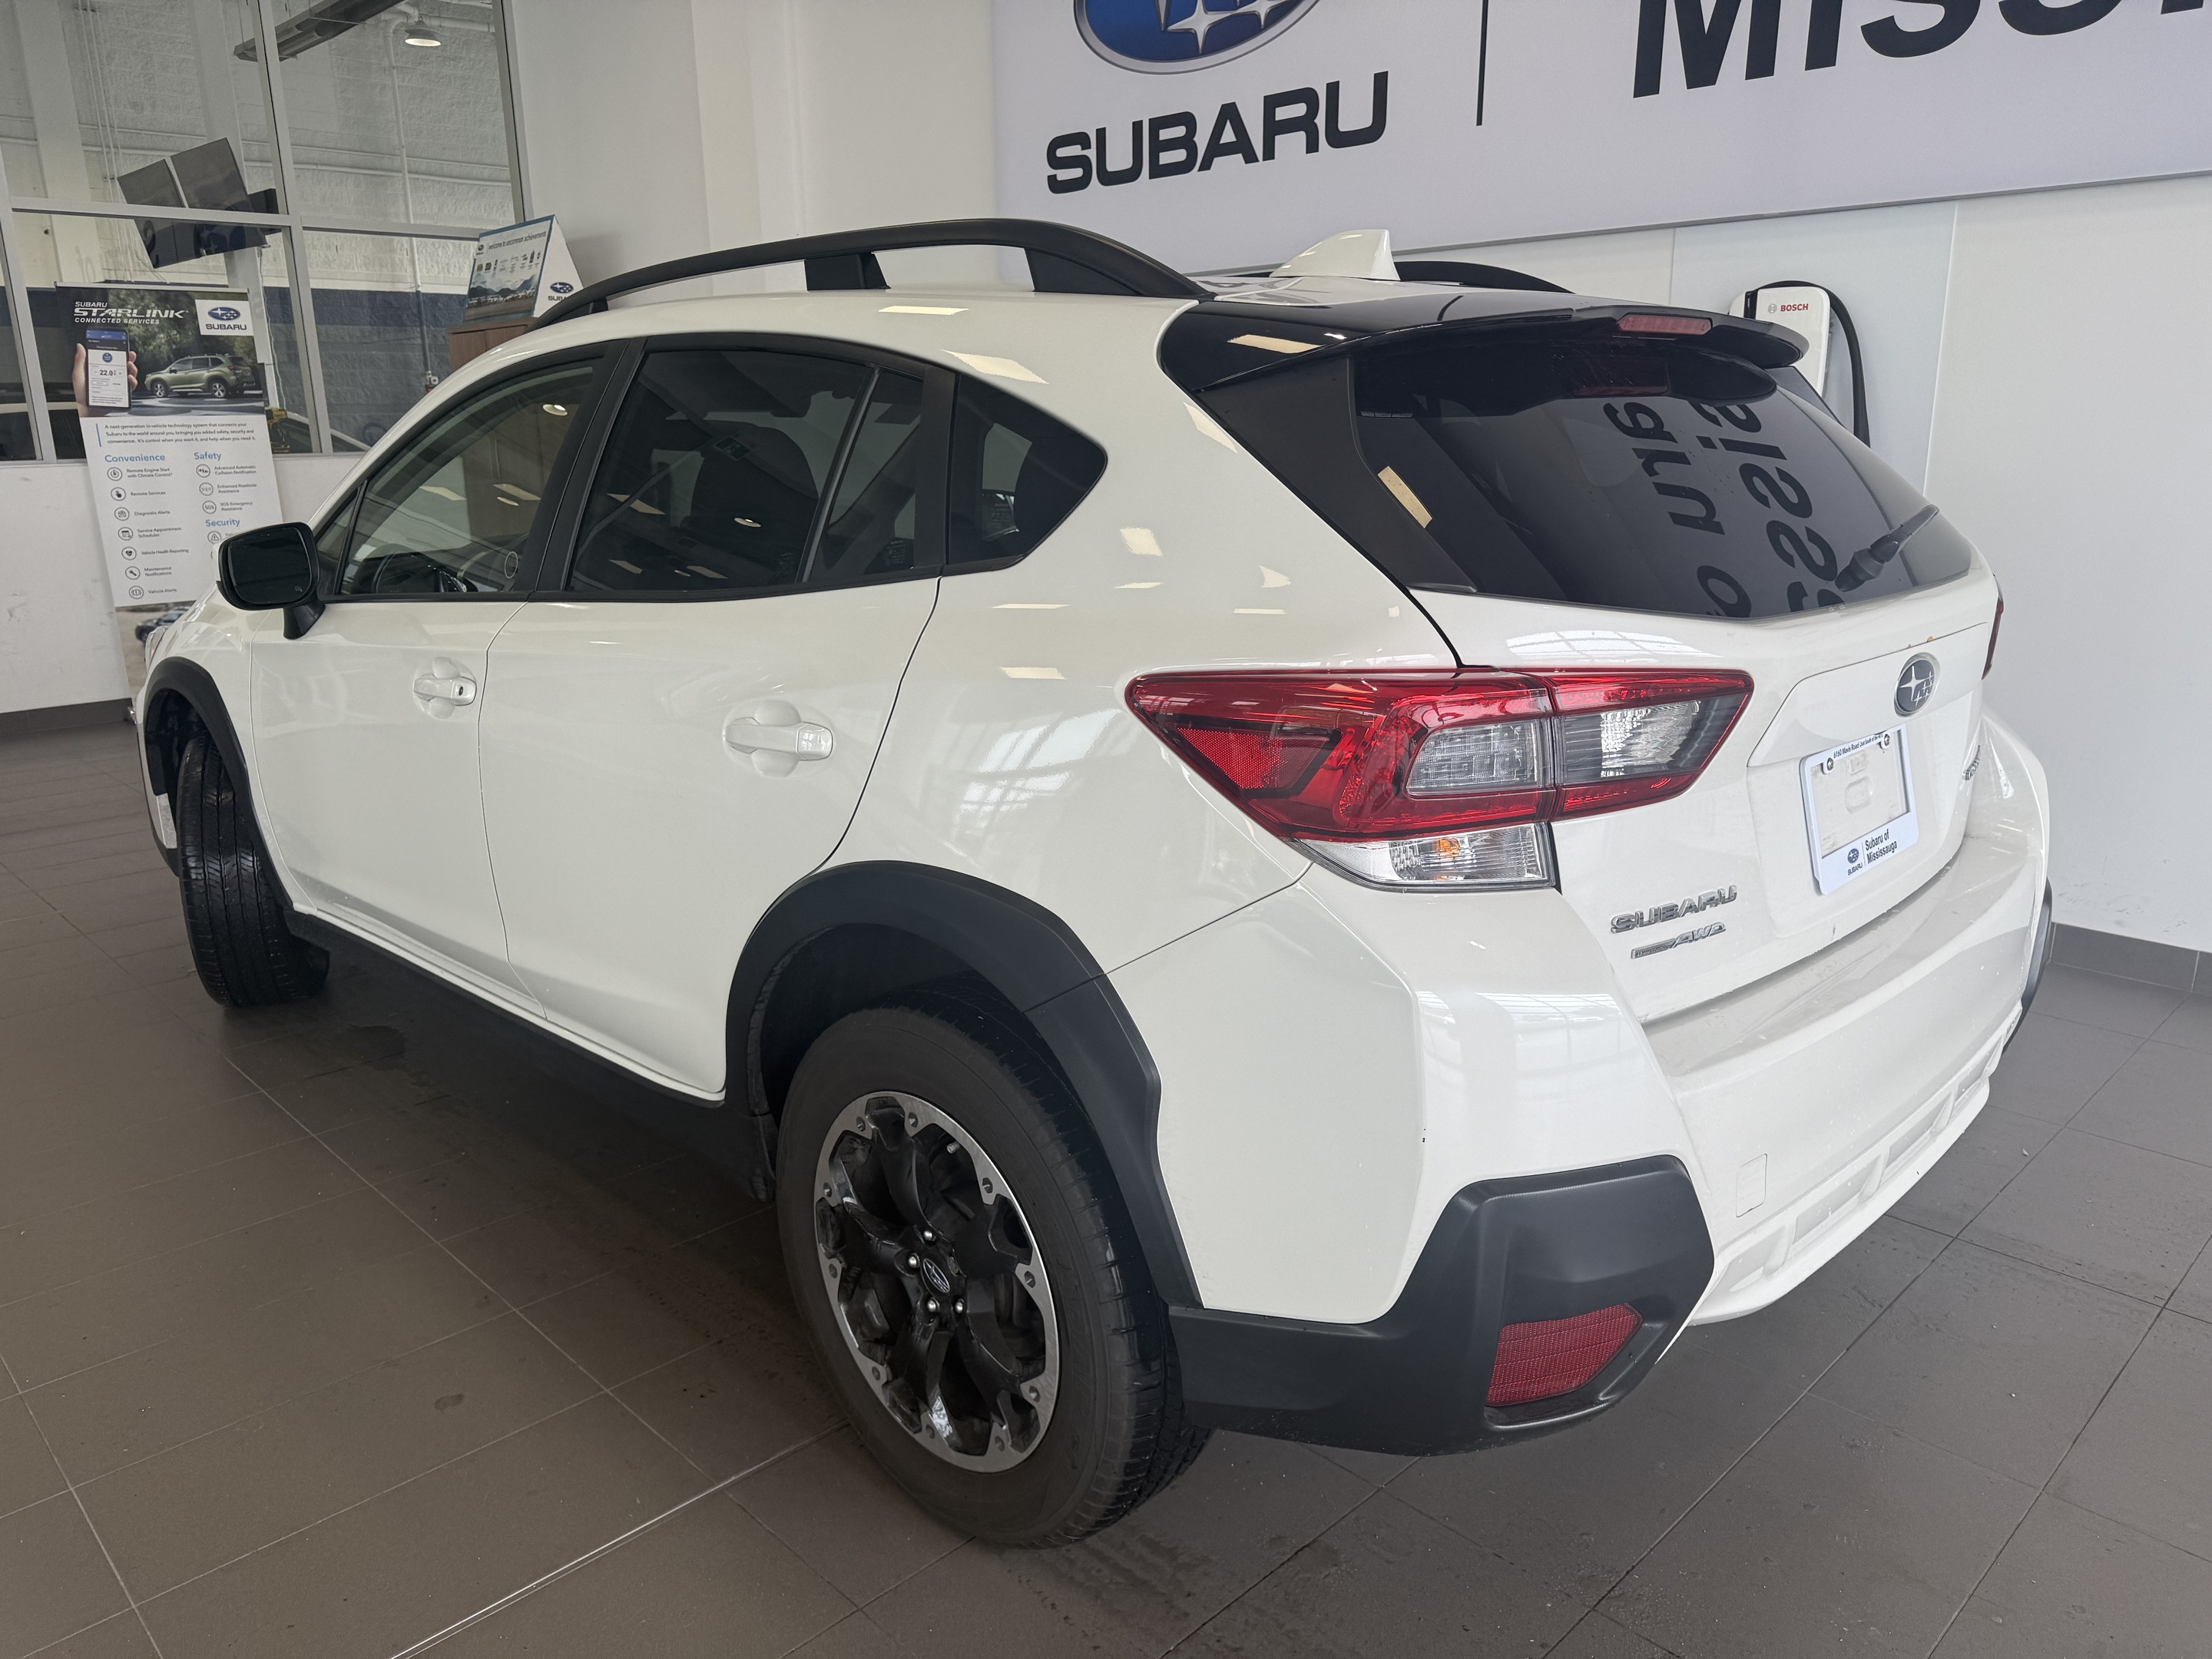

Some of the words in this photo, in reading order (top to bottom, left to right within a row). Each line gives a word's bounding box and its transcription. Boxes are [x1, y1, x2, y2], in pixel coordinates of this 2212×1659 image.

[1046, 71, 1389, 194] SUBARU
[74, 307, 186, 319] STARLINK
[1780, 303, 1809, 312] BOSCH
[104, 454, 165, 462] Convenience
[194, 452, 221, 461] Safety
[205, 518, 240, 527] Security
[1833, 749, 1842, 758] 6160
[1842, 746, 1850, 755] Mavis
[1865, 837, 1883, 851] Subaru
[1884, 829, 1889, 841] of
[1867, 841, 1897, 864] Mississauga
[1847, 862, 1863, 876] SUBARU
[1611, 884, 1737, 933] SUBARU
[1670, 922, 1727, 949] AWD
